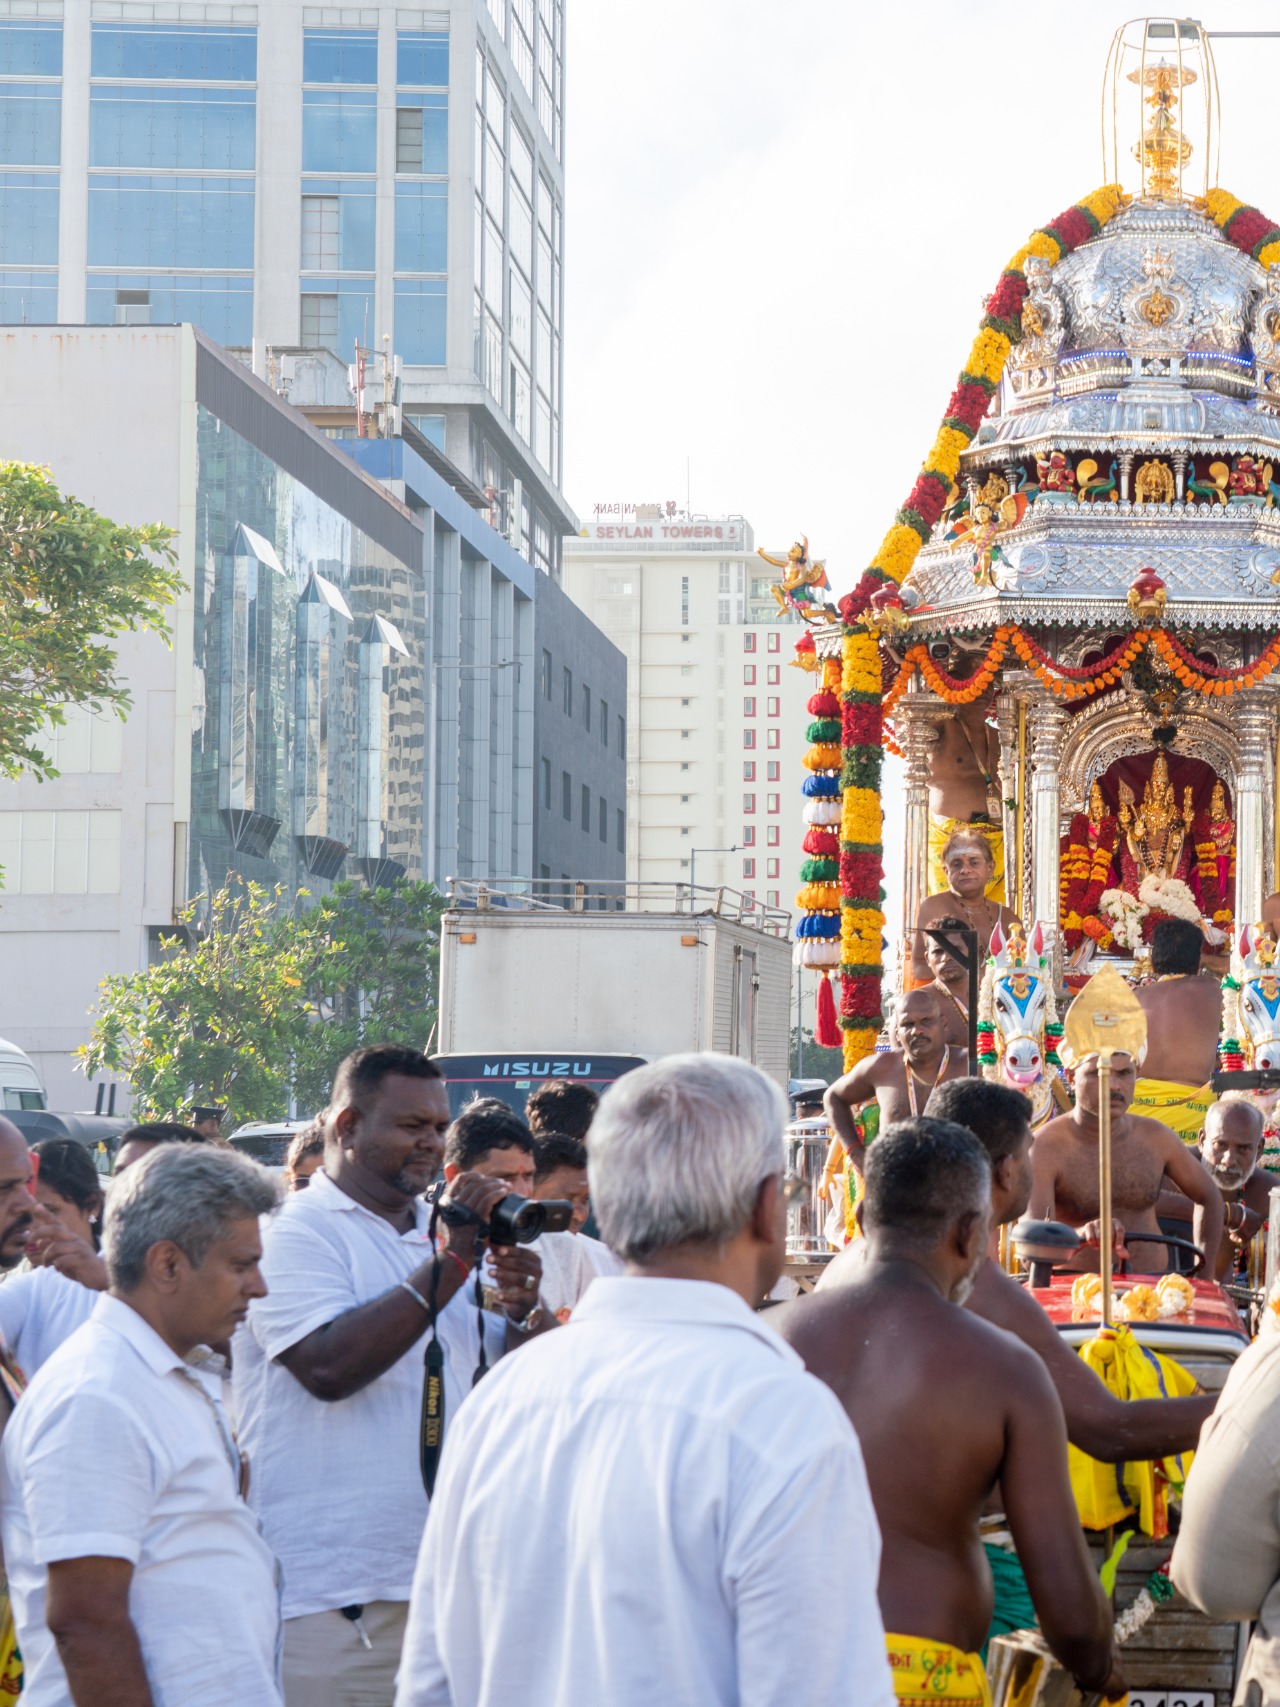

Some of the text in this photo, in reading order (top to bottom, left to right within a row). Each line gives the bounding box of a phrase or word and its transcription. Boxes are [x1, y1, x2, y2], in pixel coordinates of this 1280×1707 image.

[596, 526, 723, 539] SEYLAN TOWERS
[428, 1376, 440, 1415] Nikon
